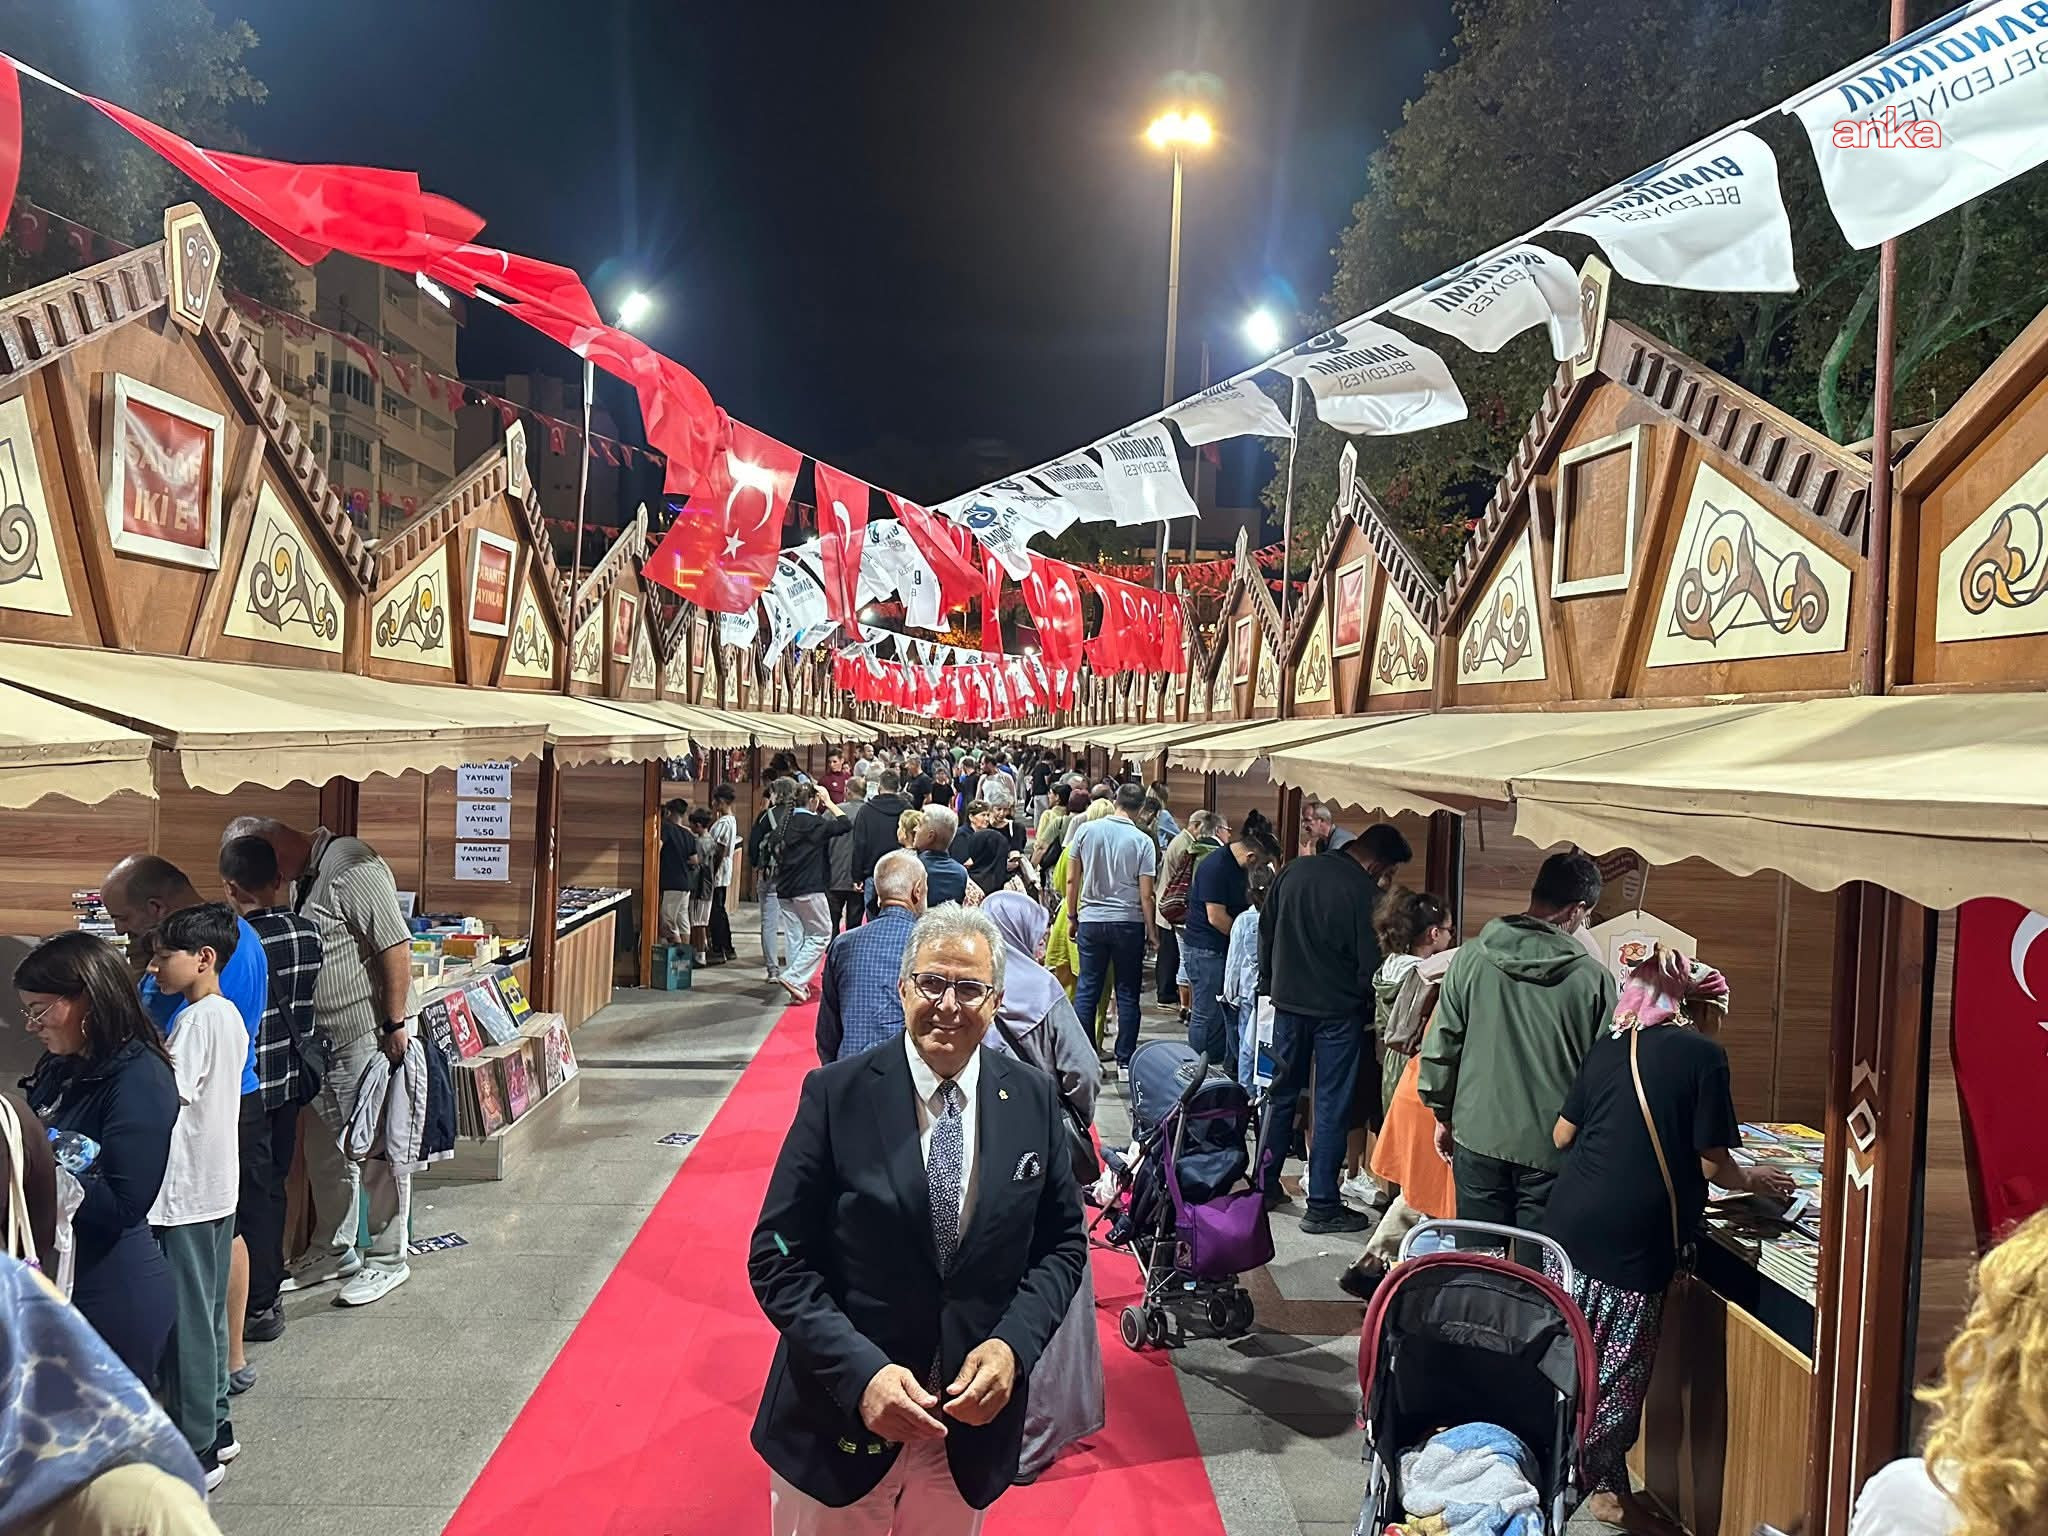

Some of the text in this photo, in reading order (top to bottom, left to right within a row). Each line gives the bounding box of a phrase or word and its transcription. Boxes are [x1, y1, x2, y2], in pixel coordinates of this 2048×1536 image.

[465, 774, 504, 782] YAYINEVİ
[474, 787, 495, 795] %50
[472, 804, 497, 812] ÇİZGE
[465, 815, 503, 823] YAYINEVİ
[473, 828, 494, 836] %50
[473, 867, 492, 875] %20
